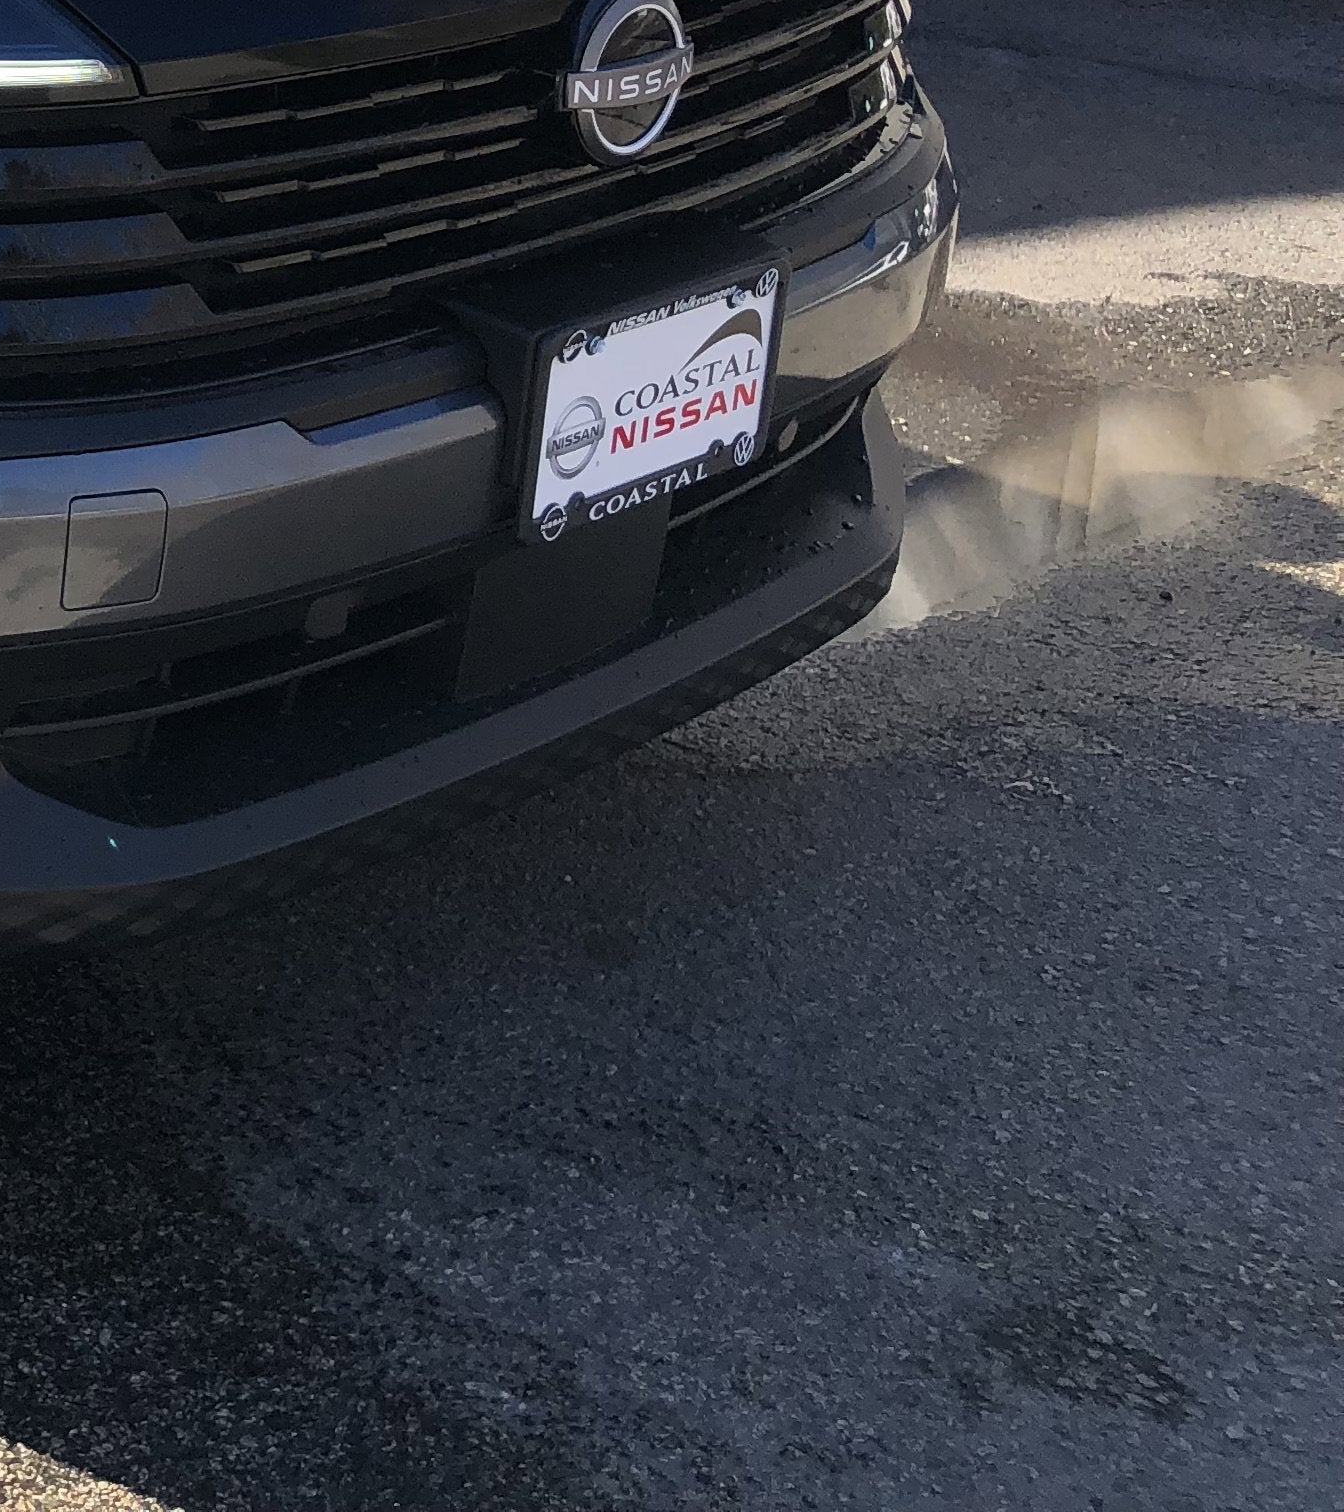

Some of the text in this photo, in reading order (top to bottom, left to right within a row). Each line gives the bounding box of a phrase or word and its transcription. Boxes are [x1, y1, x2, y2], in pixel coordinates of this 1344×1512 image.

[572, 51, 694, 104] NISSAN
[606, 304, 672, 337] NISSAN
[615, 348, 760, 417] COASTAL
[550, 424, 601, 452] NISSAN
[610, 378, 758, 455] NISSAN
[588, 462, 709, 522] COASTAL
